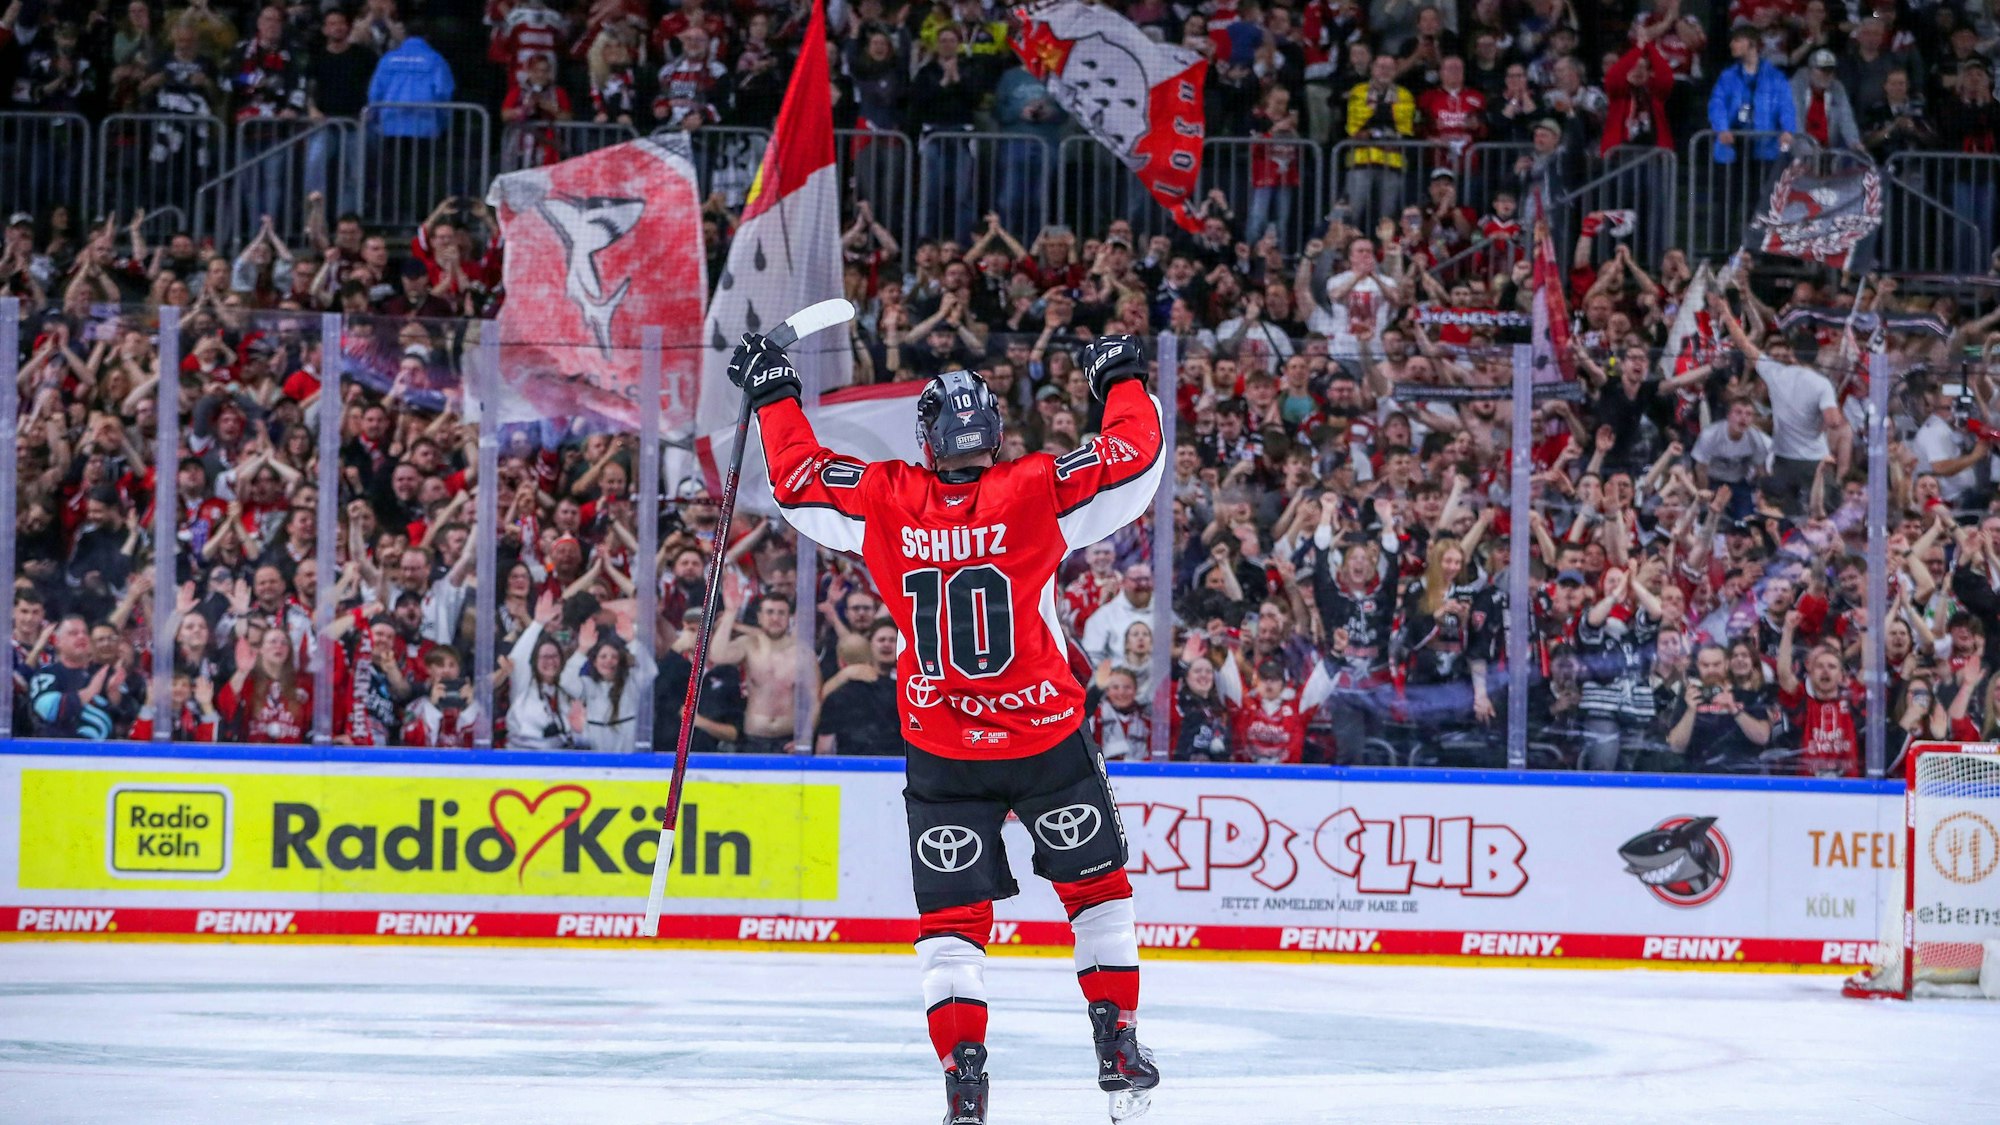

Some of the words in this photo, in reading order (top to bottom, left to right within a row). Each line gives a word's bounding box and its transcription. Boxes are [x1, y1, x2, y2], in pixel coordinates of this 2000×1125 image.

[954, 394, 972, 410] 10
[901, 523, 1007, 562] SCHÜTZ
[902, 563, 1015, 680] 10
[949, 680, 1059, 717] TOYOTA
[130, 805, 209, 829] Radio
[137, 834, 199, 857] Köln
[272, 798, 516, 873] Radio
[563, 803, 751, 876] Köln
[1314, 807, 1529, 898] CLUB
[1221, 897, 1260, 910] JETZT
[1263, 898, 1334, 911] ANMELDEN
[1337, 899, 1363, 912] AUF
[1805, 896, 1856, 919] KÖLN
[1917, 901, 2000, 926] ebens
